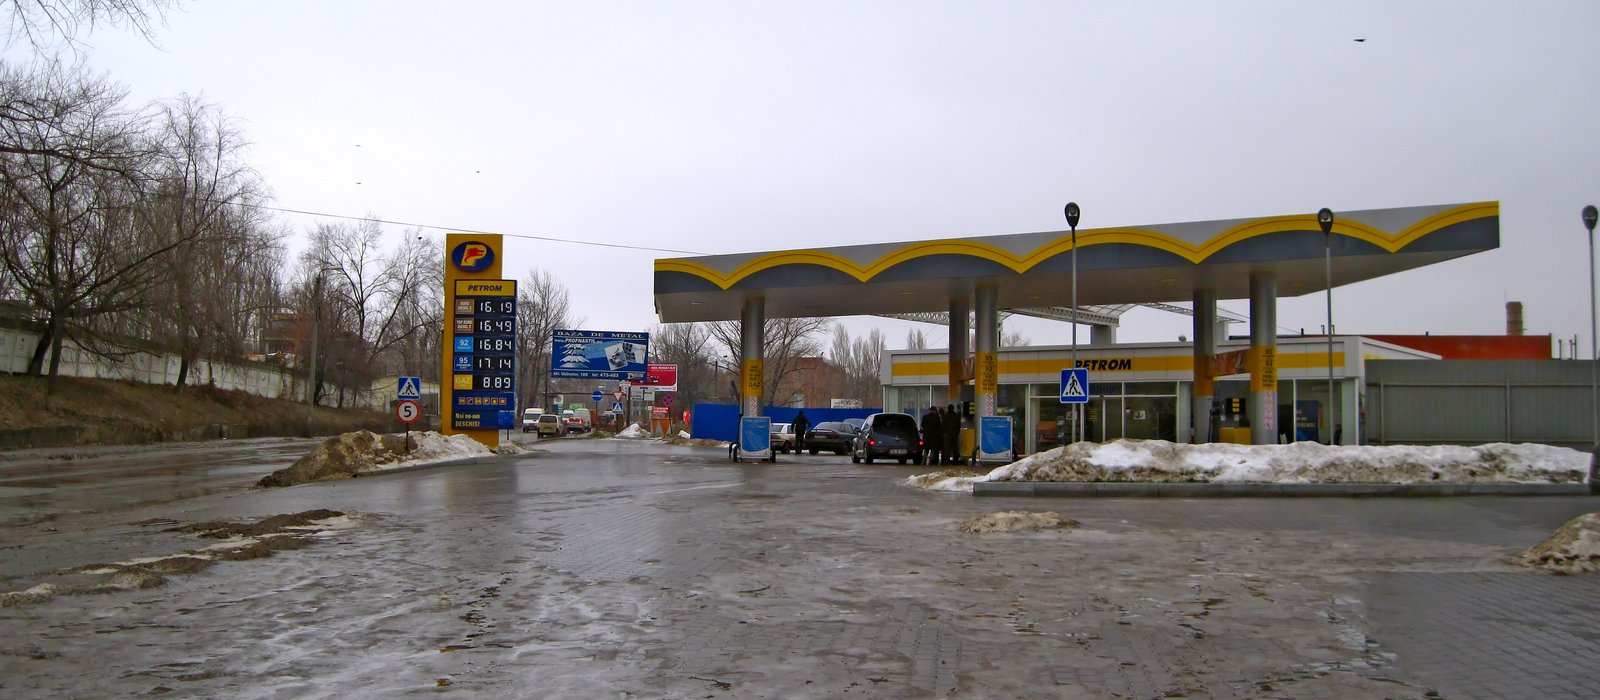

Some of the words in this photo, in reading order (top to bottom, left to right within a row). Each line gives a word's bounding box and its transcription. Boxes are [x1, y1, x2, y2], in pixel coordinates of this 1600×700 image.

[480, 301, 512, 313] 16.19
[479, 320, 512, 332] 16.49
[479, 339, 512, 351] 16.84
[479, 357, 511, 369] 17.14
[1075, 359, 1132, 371] PETROM
[483, 376, 511, 388] 8.89
[404, 405, 412, 418] 5
